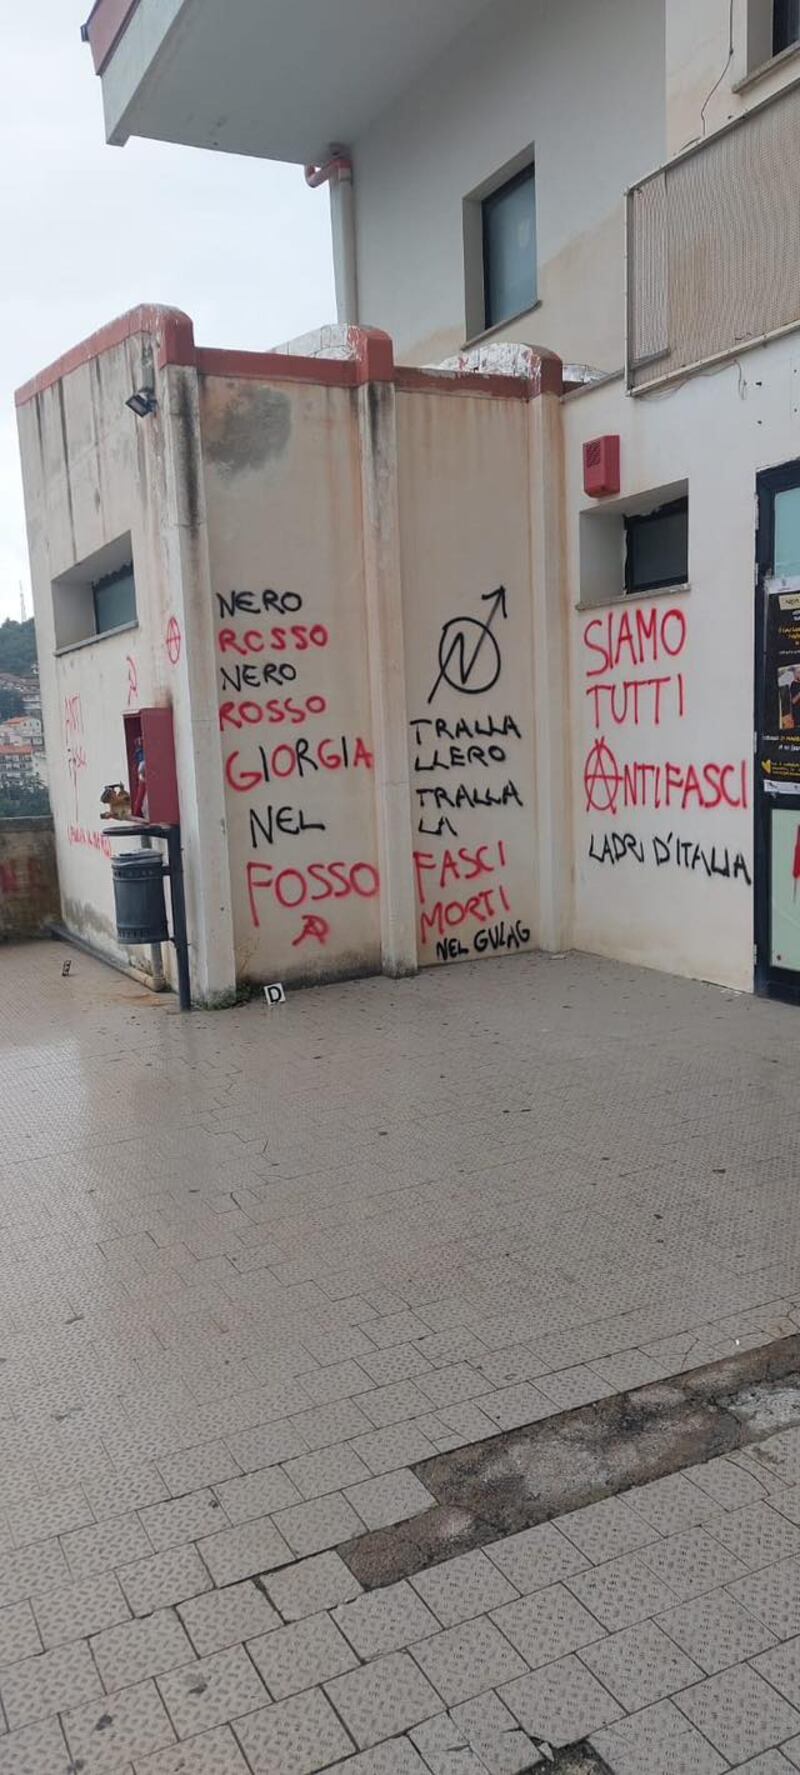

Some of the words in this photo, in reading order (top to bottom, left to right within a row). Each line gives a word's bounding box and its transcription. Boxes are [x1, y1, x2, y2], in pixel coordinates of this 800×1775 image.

[216, 589, 302, 619] NERO
[583, 608, 686, 677] SIAMO
[220, 663, 297, 692] NERO
[219, 695, 326, 732] ROSSO
[586, 673, 684, 729] TUTTI
[410, 715, 521, 745] TRALLA
[225, 736, 373, 792] GIORGIA
[414, 745, 506, 771] LLERO
[583, 736, 748, 815] ANTIFASCI
[416, 780, 523, 808] TRALLA
[249, 805, 326, 848] NEL
[418, 816, 458, 837] LA
[413, 840, 505, 904] FASCI
[589, 832, 645, 865] LADRI
[653, 832, 752, 886] D'ITALIA
[246, 862, 380, 927] FOSSO
[420, 885, 510, 944] MORTI
[436, 938, 469, 960] NEL
[267, 986, 281, 1002] D
